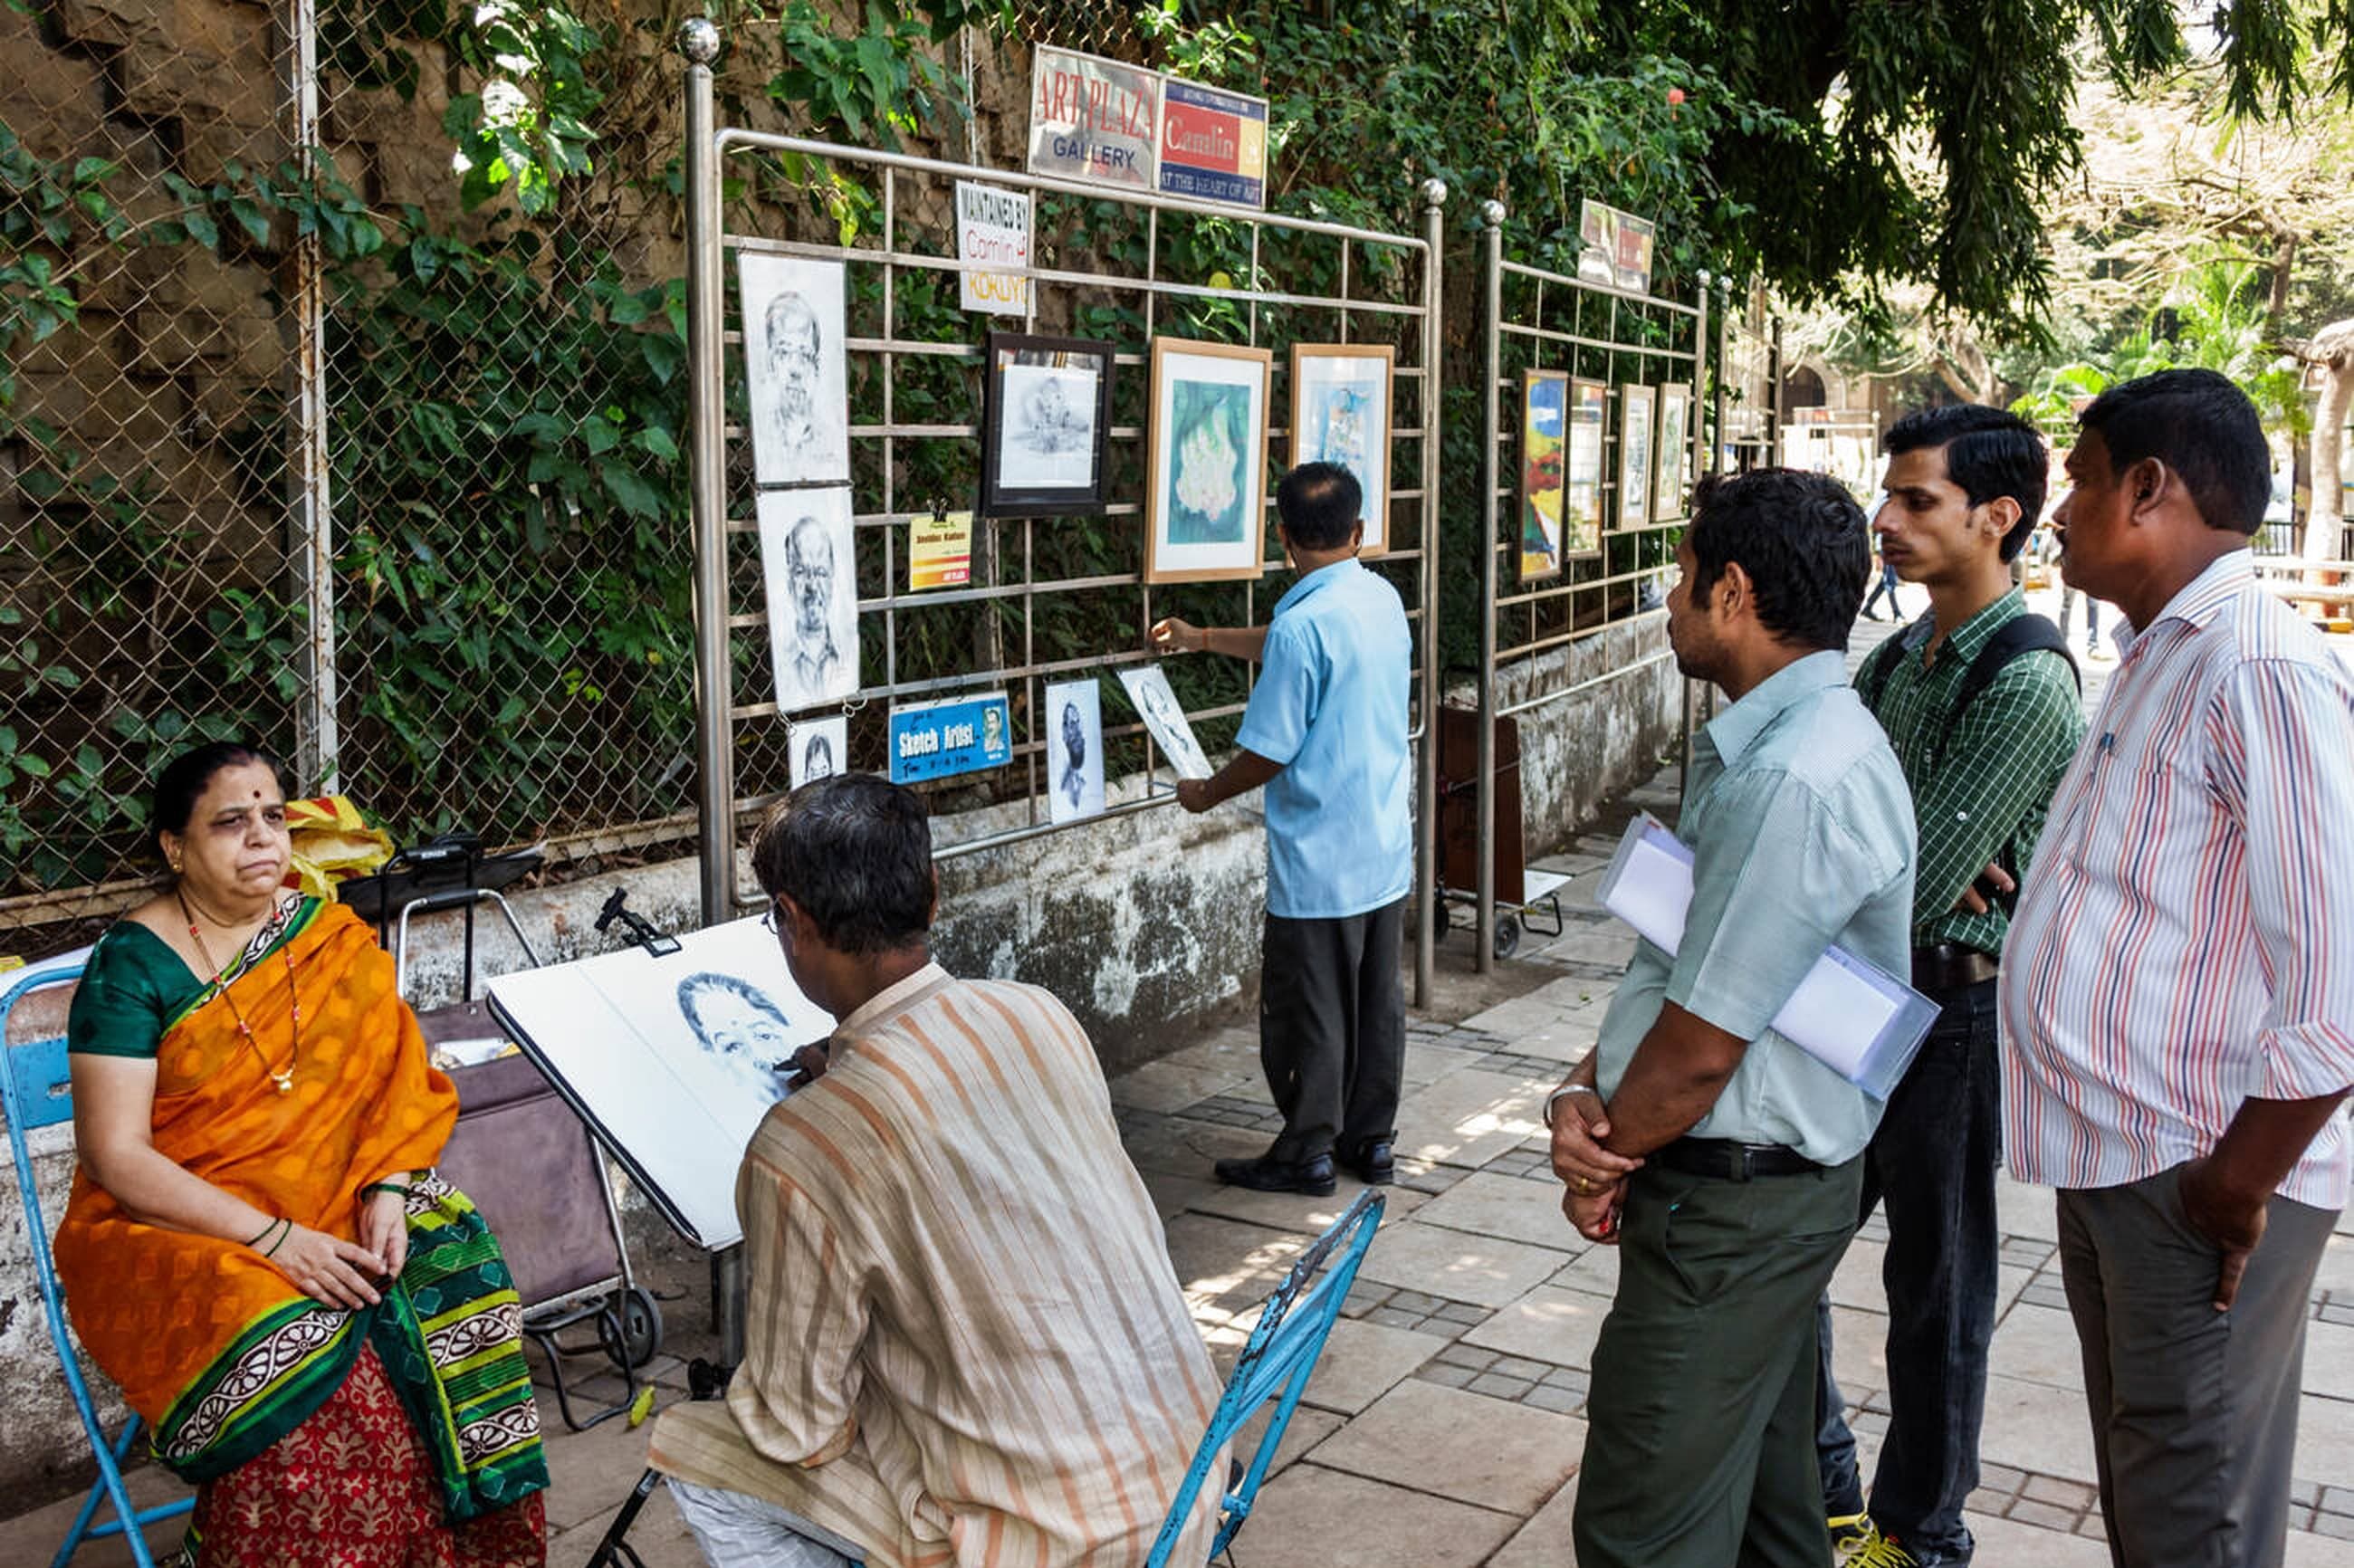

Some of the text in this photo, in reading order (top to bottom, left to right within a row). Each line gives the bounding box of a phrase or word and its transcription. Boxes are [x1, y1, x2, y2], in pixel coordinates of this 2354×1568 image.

[1036, 70, 1155, 142] ART PLAZA
[1053, 136, 1135, 170] GALLERY
[1165, 115, 1234, 160] Camlin
[1162, 171, 1173, 187] AT
[1174, 173, 1194, 191] THE
[961, 186, 1029, 231] MAINTAINED BY
[899, 728, 940, 759] Sketch
